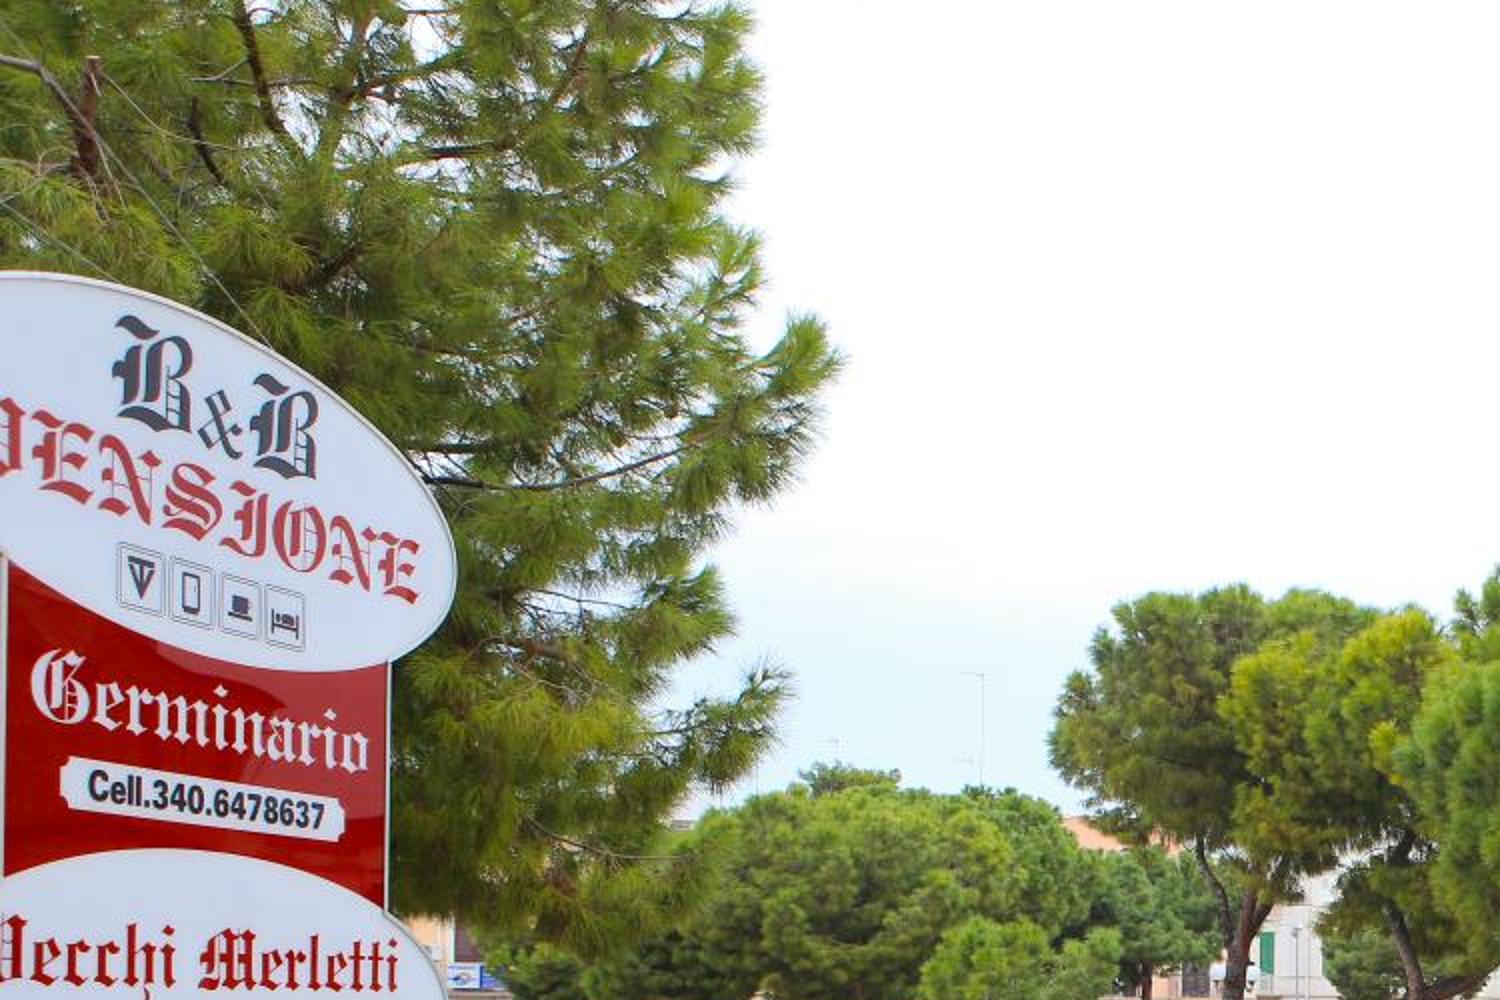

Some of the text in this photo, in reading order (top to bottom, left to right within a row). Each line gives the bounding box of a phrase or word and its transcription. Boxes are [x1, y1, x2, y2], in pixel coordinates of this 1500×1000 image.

[112, 315, 319, 480] B&B
[31, 649, 369, 773] Germinario
[88, 769, 326, 830] Cell.340.6478637
[198, 928, 399, 994] Merletti
